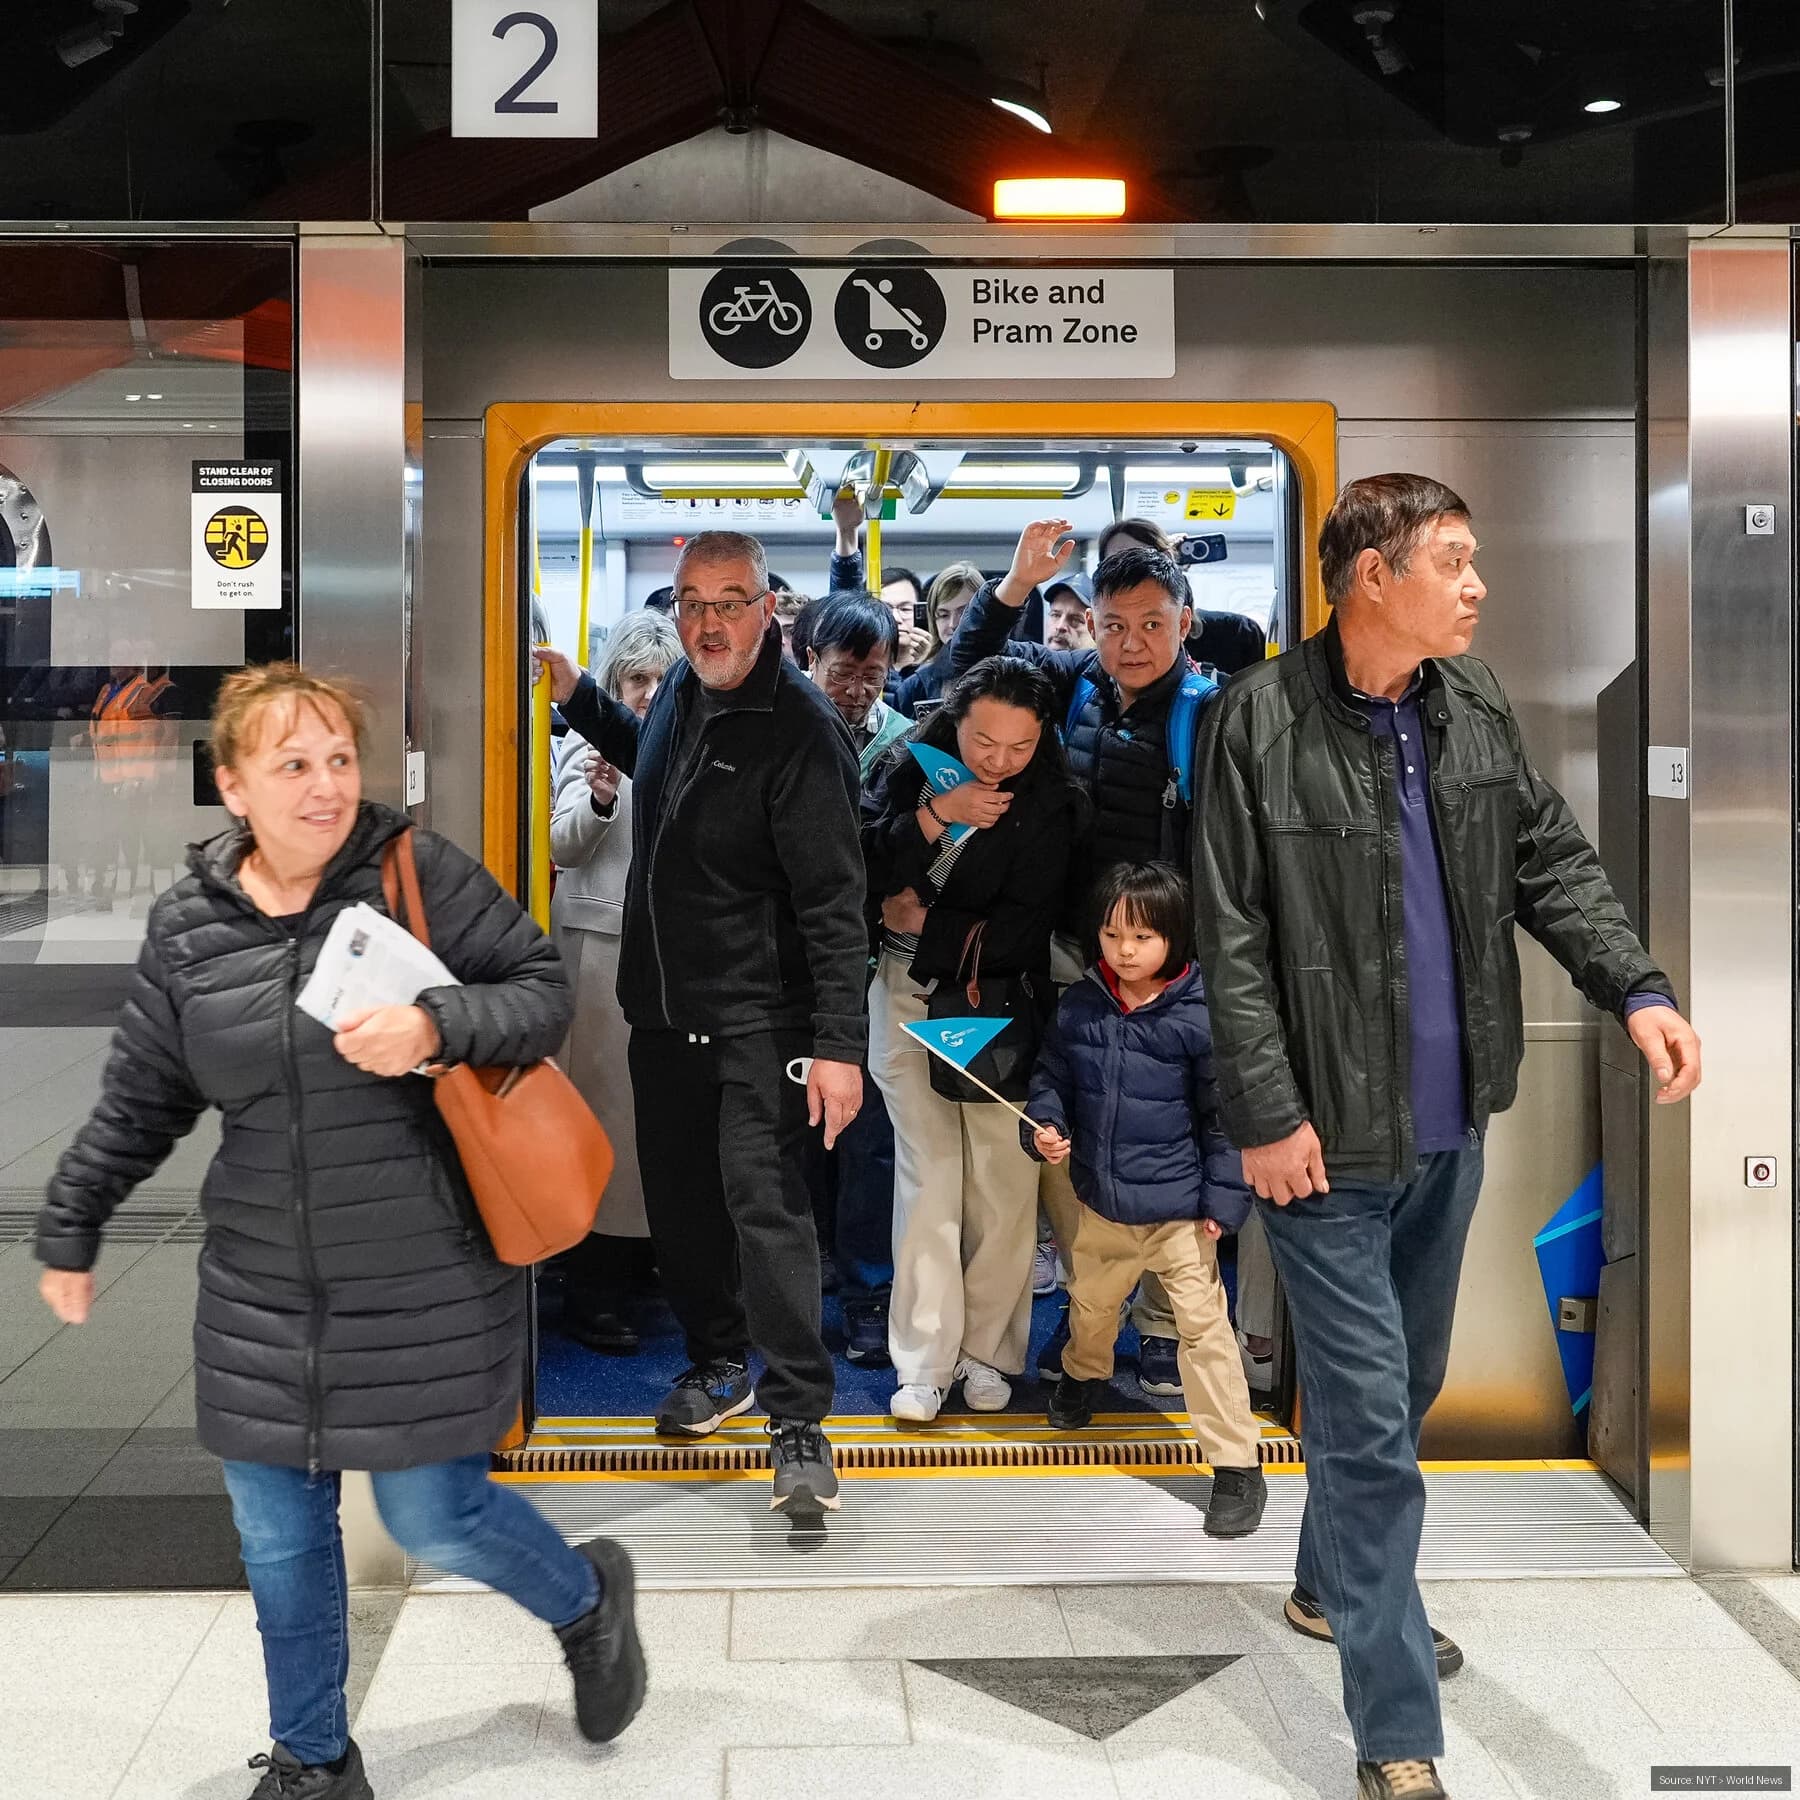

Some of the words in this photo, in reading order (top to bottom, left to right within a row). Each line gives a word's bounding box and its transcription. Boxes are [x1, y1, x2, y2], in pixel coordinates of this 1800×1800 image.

[491, 11, 559, 114] 2
[972, 278, 1039, 304] Bike
[1048, 278, 1105, 304] and
[972, 317, 1053, 344] Pram
[1062, 317, 1138, 344] Zone
[199, 467, 229, 476] STAND
[229, 467, 260, 476] CLEAR
[260, 467, 274, 476] OF
[200, 477, 241, 486] CLOSING
[241, 477, 273, 486] DOORS
[217, 580, 237, 588] Don't
[238, 580, 255, 588] rush
[229, 590, 241, 598] get
[1671, 763, 1684, 783] 13
